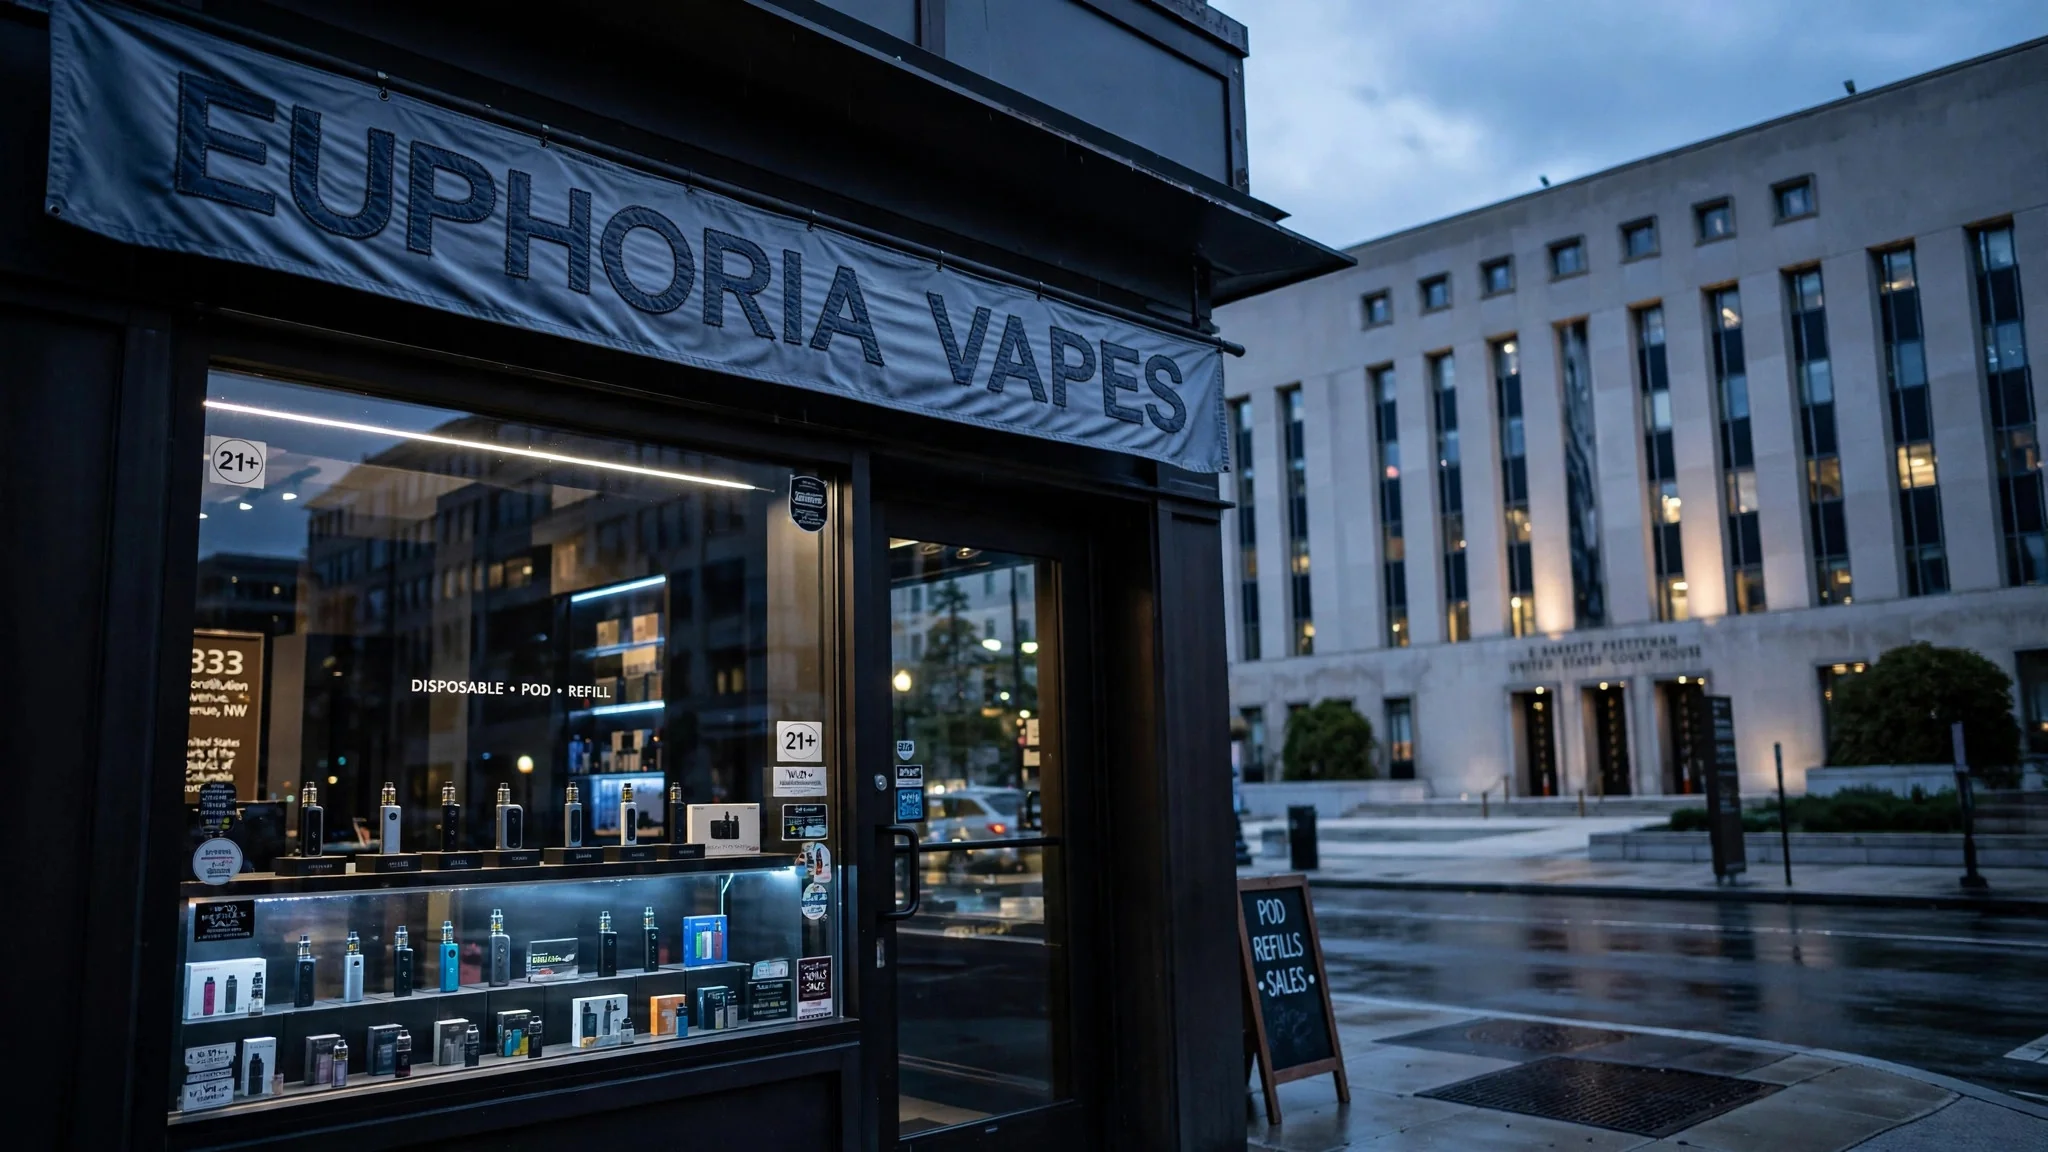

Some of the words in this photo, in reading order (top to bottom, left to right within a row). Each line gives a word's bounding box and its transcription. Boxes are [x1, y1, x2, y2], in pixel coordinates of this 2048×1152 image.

[175, 71, 884, 366] EUPHORIA
[927, 291, 1187, 433] VAPES
[219, 450, 259, 472] 21+
[191, 648, 243, 675] 333
[411, 679, 504, 695] DISPOSABLE
[521, 683, 551, 696] POD
[568, 685, 611, 698] REFILL
[189, 706, 221, 718] enue,
[224, 704, 248, 717] NW
[785, 731, 816, 750] 21+
[1257, 899, 1286, 925] POD
[1253, 932, 1304, 962] REFILLS
[1266, 966, 1307, 997] SALES
